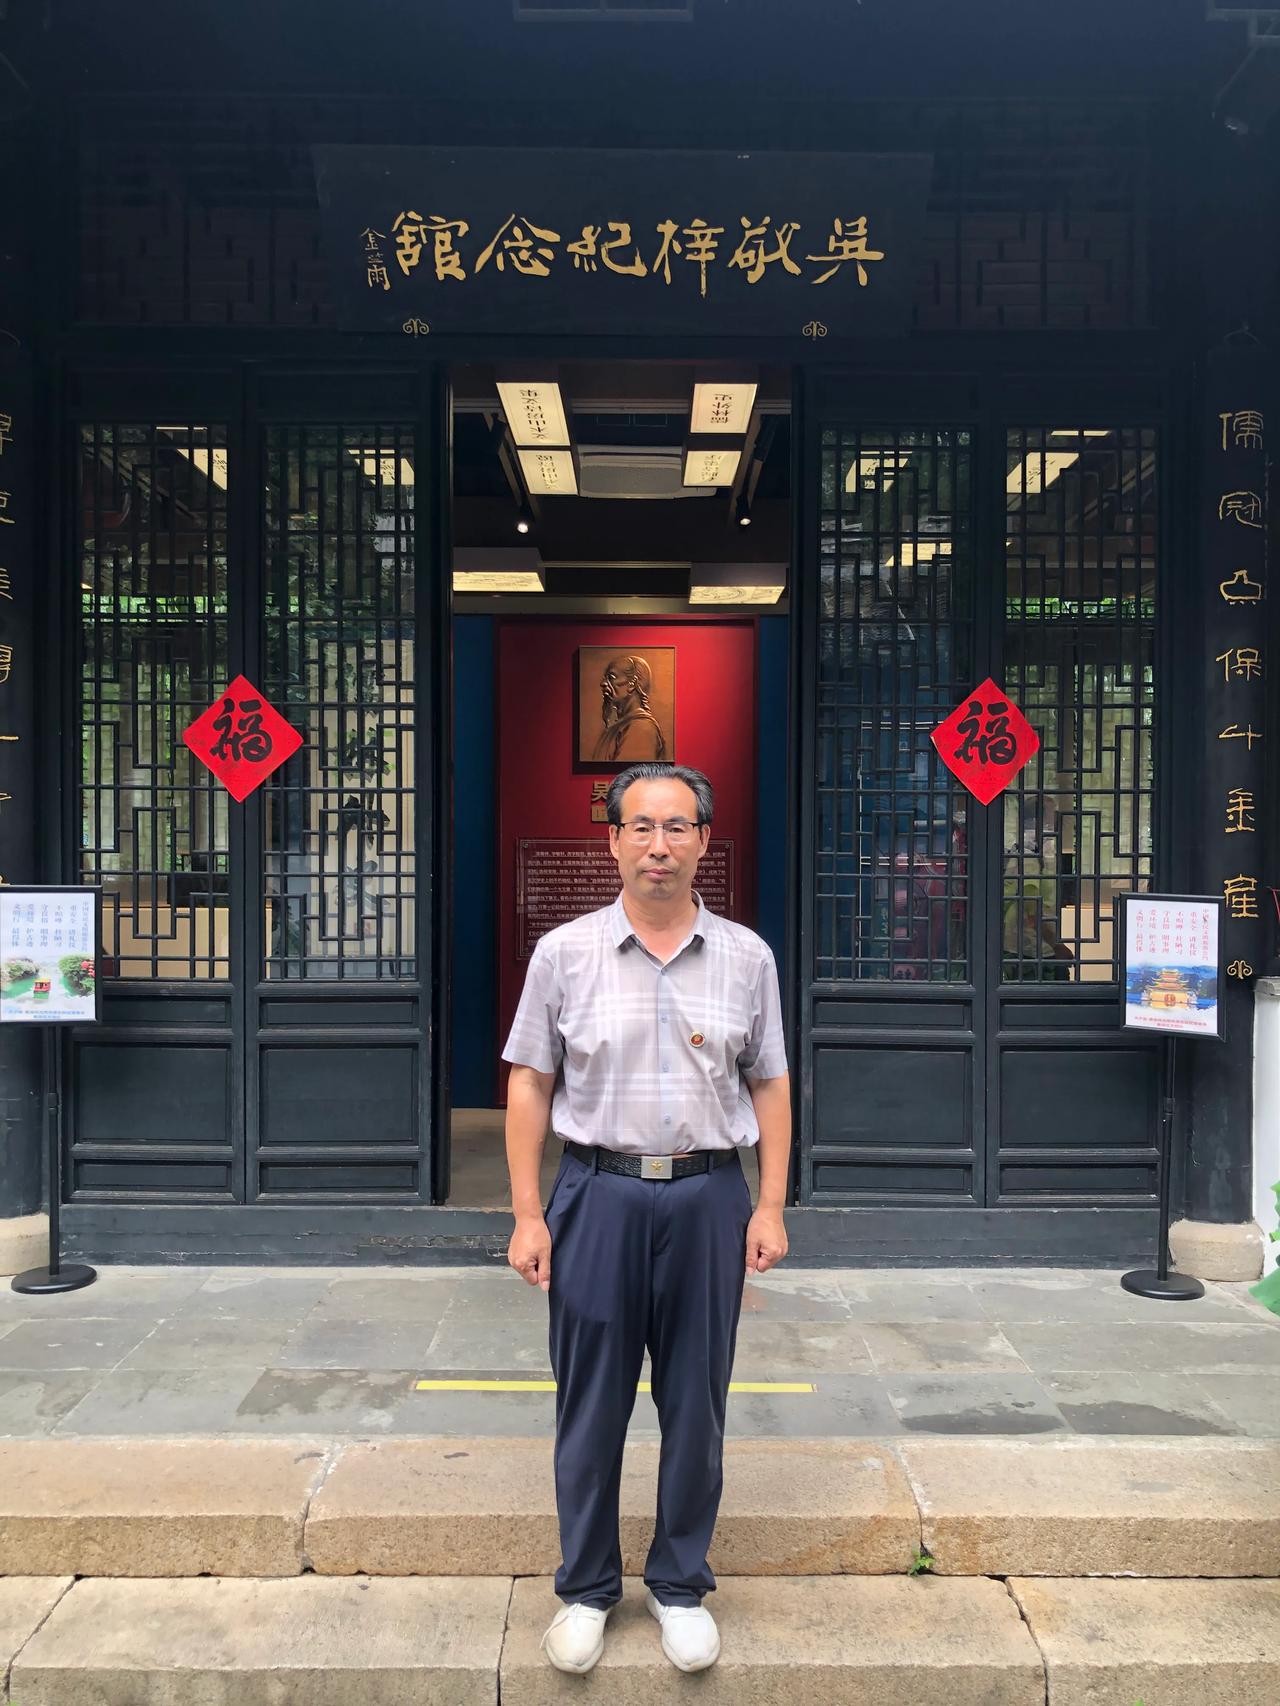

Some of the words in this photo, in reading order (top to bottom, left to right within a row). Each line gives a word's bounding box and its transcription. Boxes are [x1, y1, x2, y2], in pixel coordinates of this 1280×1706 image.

[709, 393, 735, 424] 儒林外史
[209, 697, 273, 763] 福
[954, 700, 1018, 765] 福
